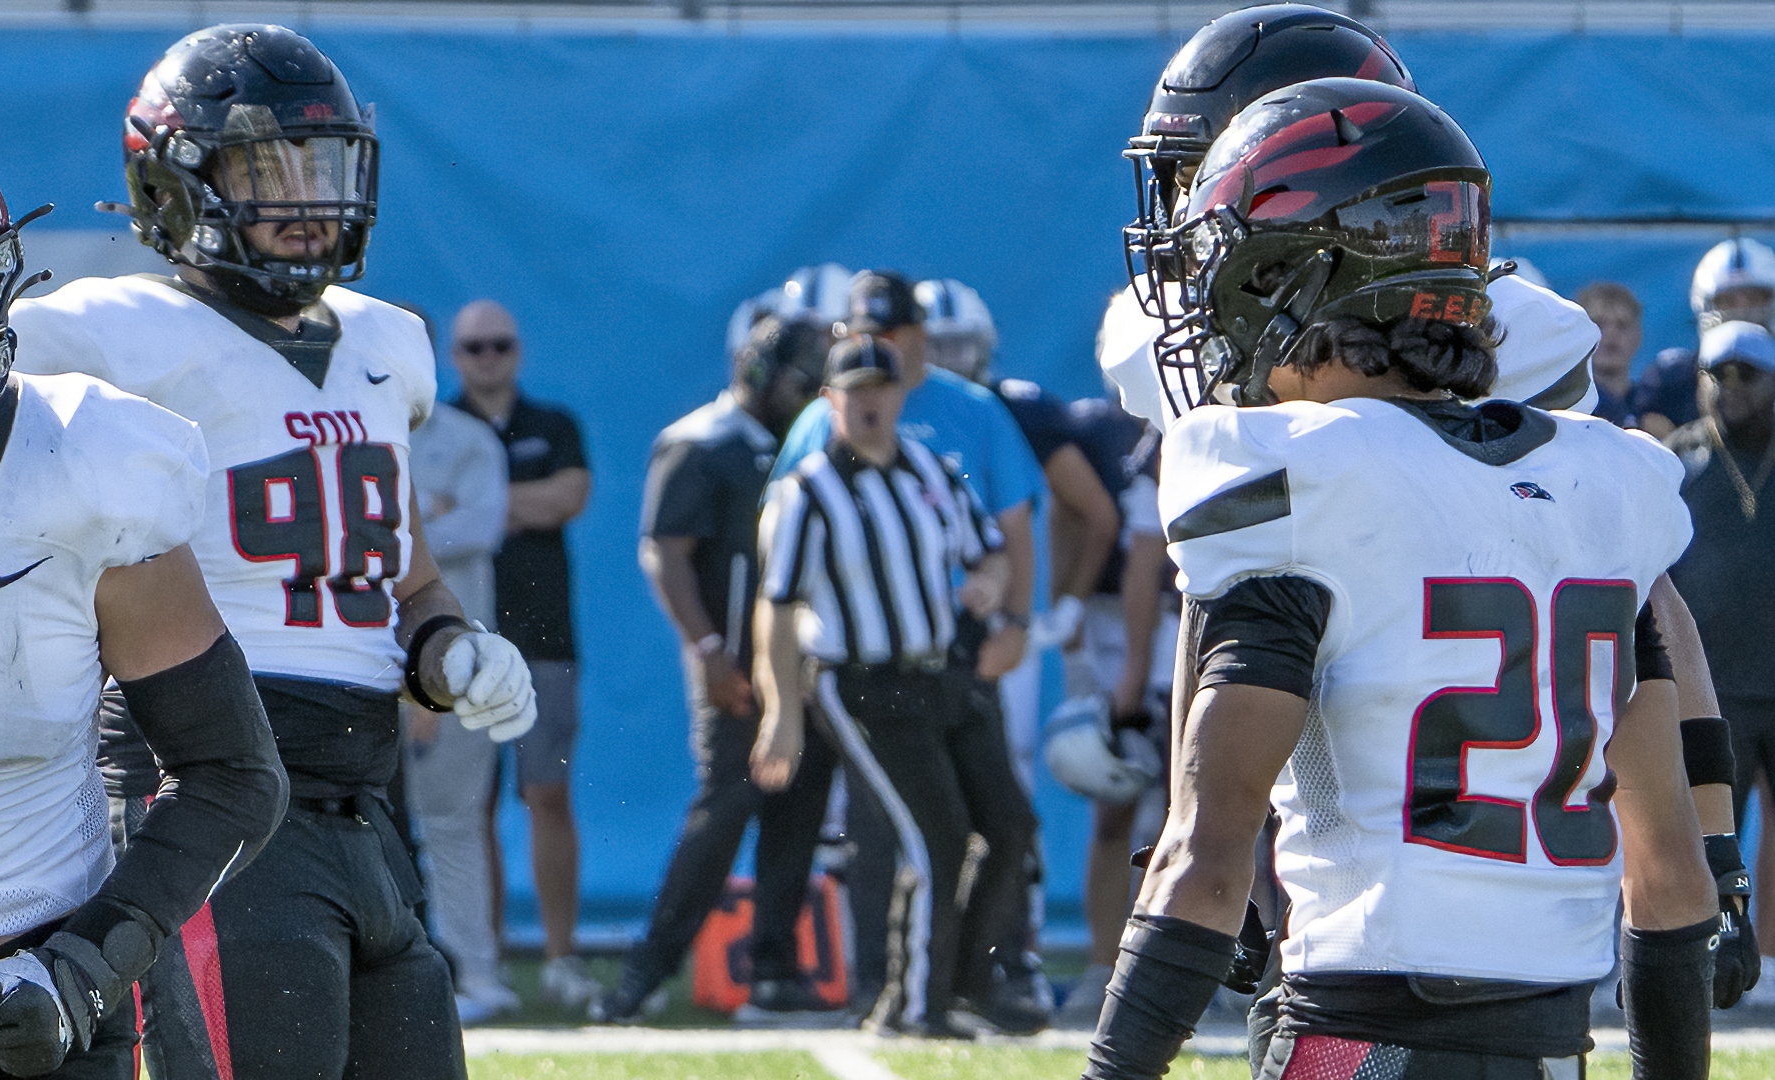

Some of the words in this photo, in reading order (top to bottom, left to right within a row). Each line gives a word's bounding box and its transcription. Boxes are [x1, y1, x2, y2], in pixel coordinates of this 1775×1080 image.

[284, 410, 368, 448] SOU
[227, 442, 400, 628] 98
[1403, 576, 1638, 867] 20
